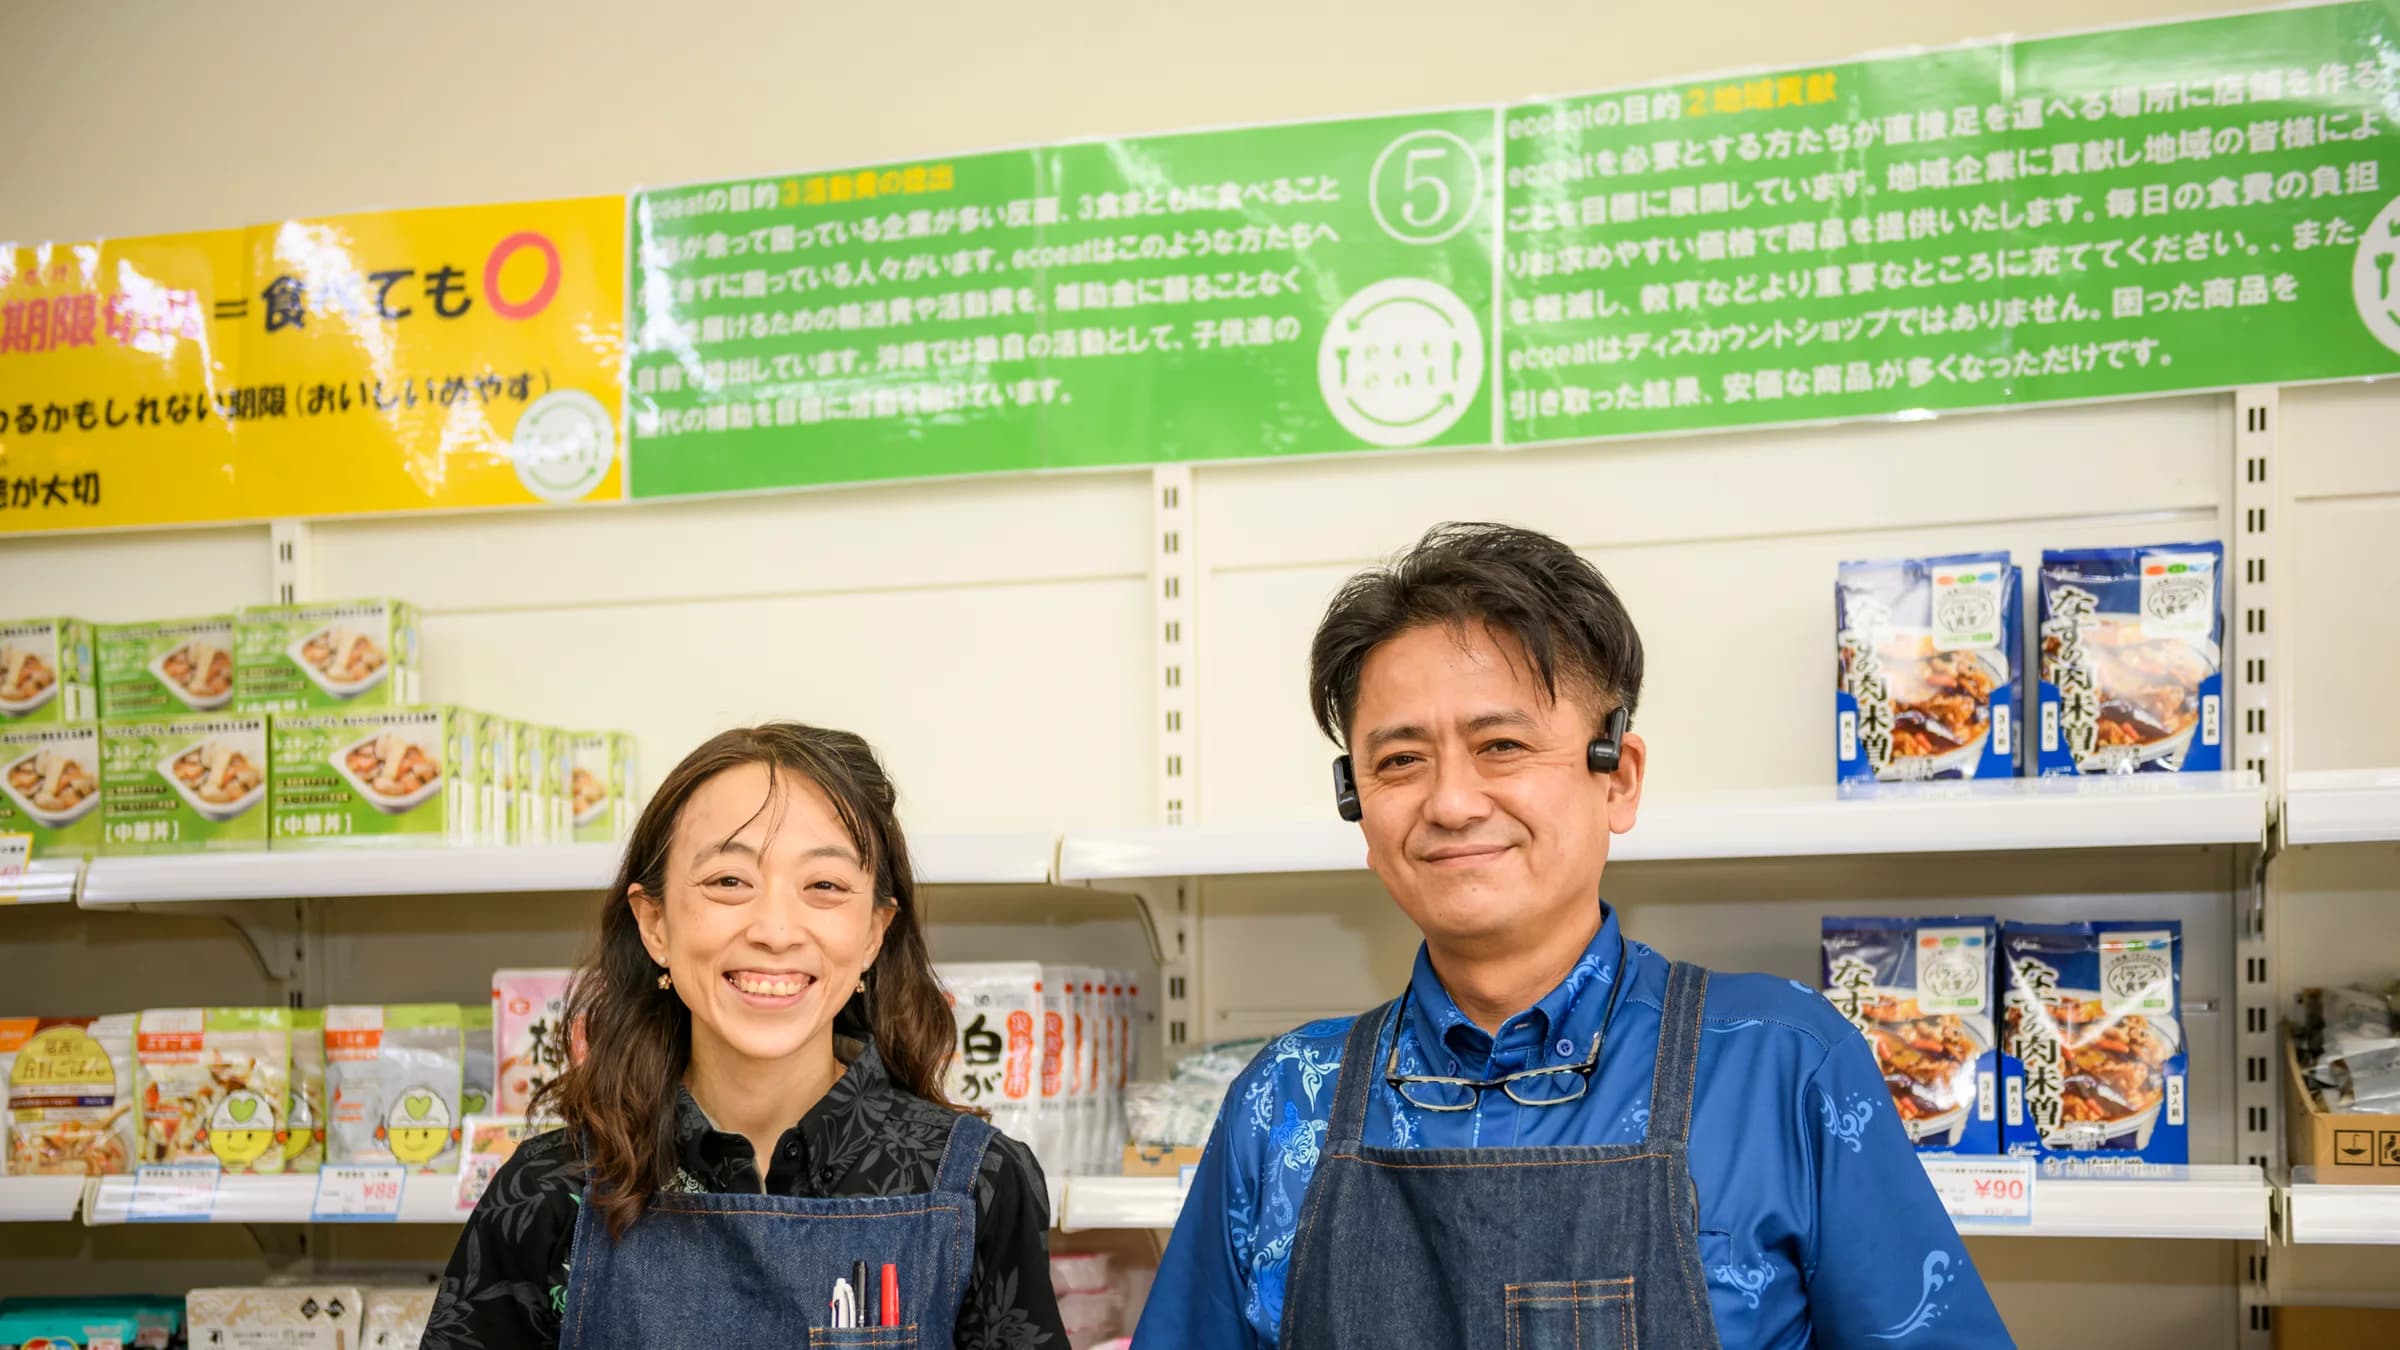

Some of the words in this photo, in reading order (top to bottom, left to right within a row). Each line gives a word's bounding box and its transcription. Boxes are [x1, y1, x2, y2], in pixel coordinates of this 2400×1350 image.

[963, 1013, 1002, 1112] 白が
[363, 1182, 399, 1201] ¥88
[1974, 1179, 2024, 1201] ¥90
